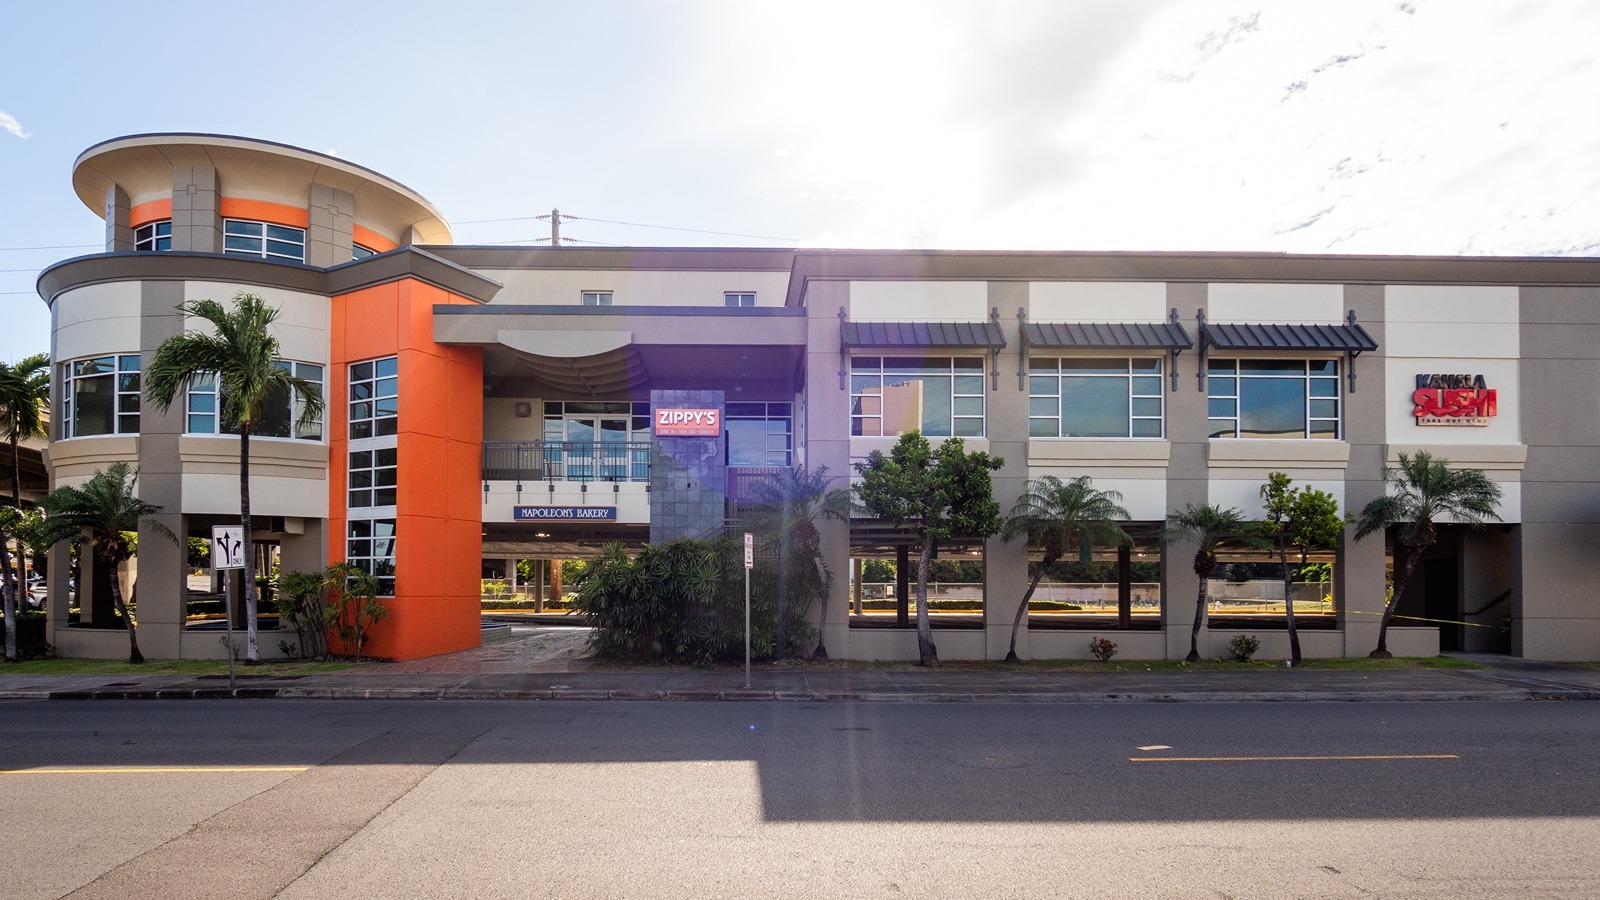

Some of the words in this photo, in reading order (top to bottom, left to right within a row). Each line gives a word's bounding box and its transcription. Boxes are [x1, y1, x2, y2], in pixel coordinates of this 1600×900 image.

[1415, 373, 1487, 389] KAHALA
[1413, 388, 1497, 417] SUSHI
[659, 411, 716, 425] ZIPPY'S
[521, 508, 573, 518] NAPOLEON'S
[577, 508, 609, 519] BAKERY
